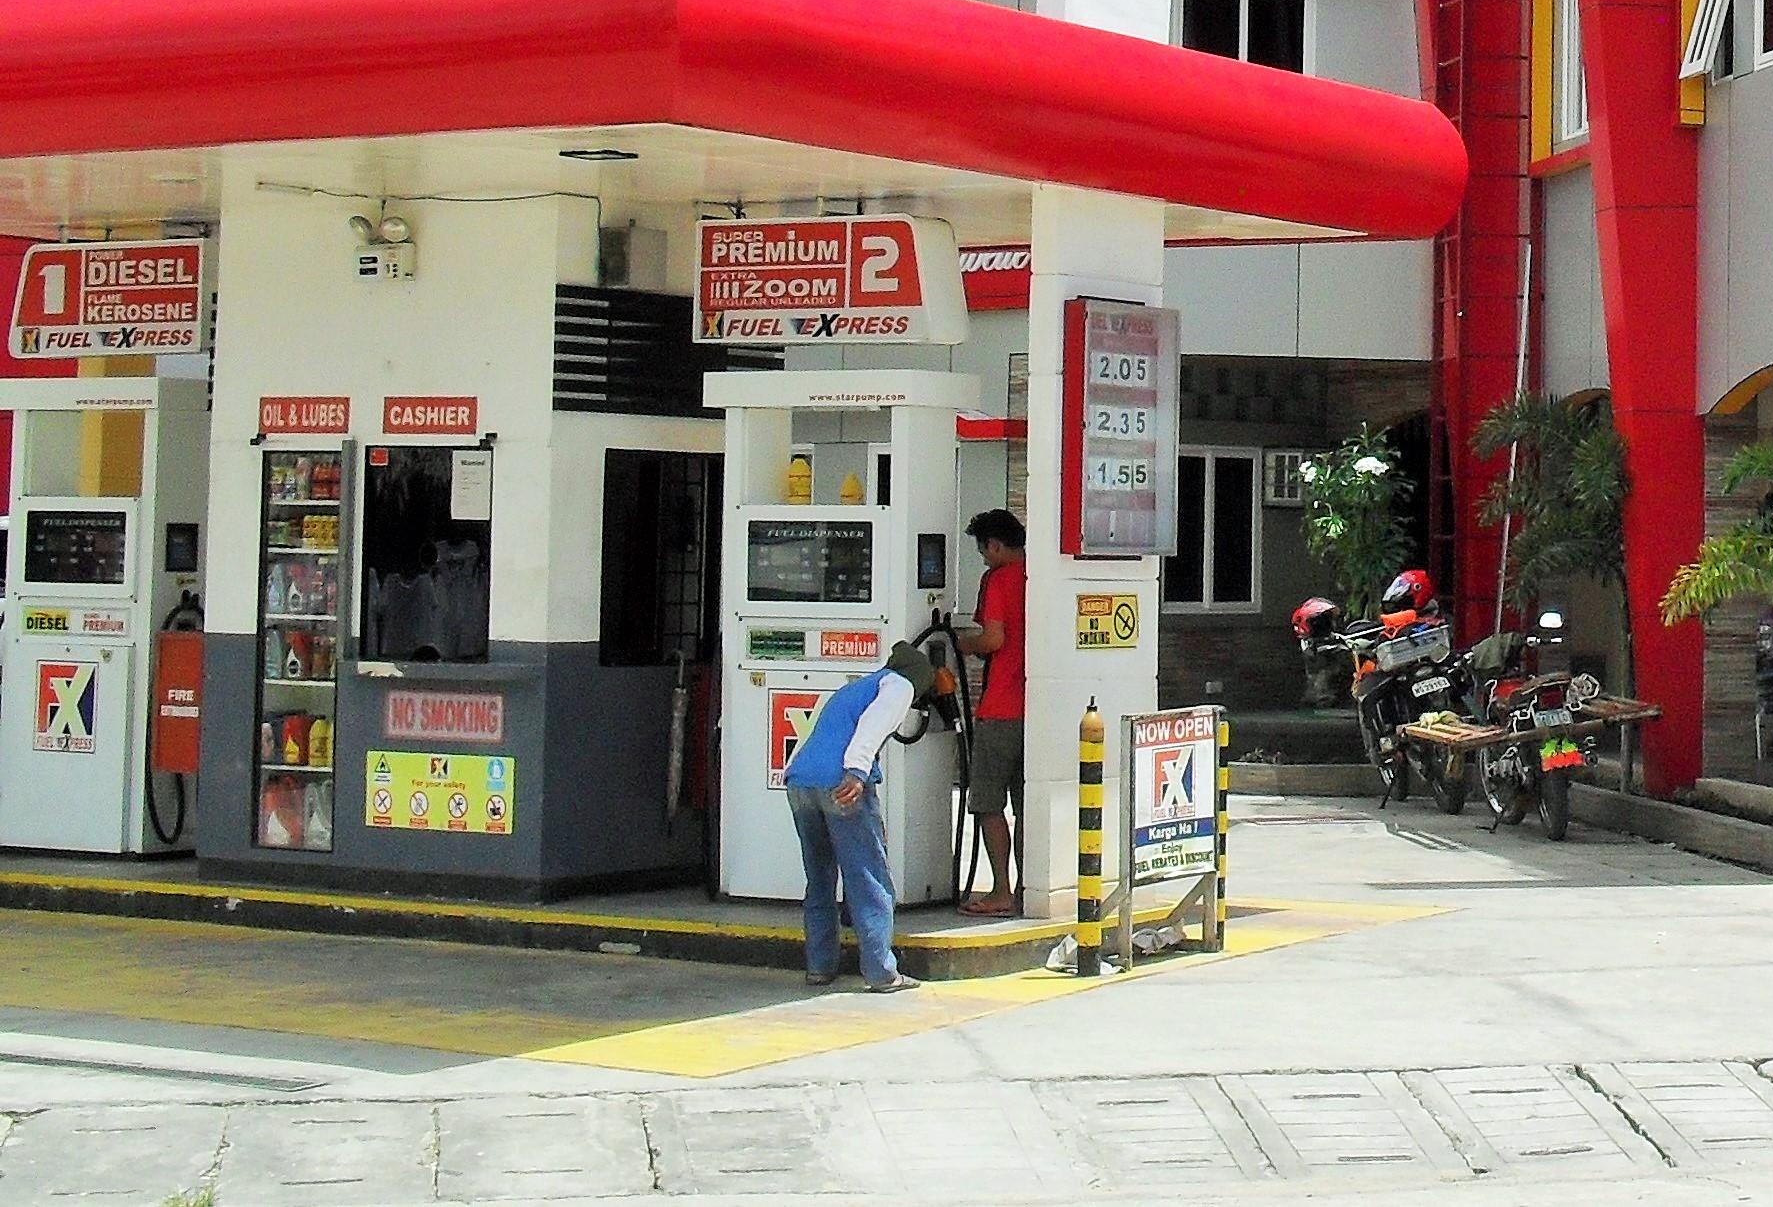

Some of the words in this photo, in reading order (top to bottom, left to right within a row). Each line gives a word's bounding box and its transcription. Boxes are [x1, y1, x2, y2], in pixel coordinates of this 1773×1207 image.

[87, 258, 193, 285] DIESEL
[861, 236, 899, 292] 2
[38, 264, 66, 315] 1
[744, 278, 838, 298] ZOOM
[87, 302, 193, 323] KEROSENE
[726, 318, 783, 337] FUEL
[798, 313, 909, 337] EXPRESS
[46, 332, 93, 348] FUEL
[106, 327, 193, 349] EXPRESS
[1099, 356, 1147, 381] 2.05
[808, 393, 906, 403] www.starpump.com
[263, 404, 284, 426] OIL
[289, 403, 298, 426] &
[301, 403, 345, 427] LUBES
[390, 405, 470, 426] CASHIER
[1097, 411, 1146, 434] 2.35
[26, 616, 69, 630] DIESEL
[1079, 632, 1110, 645] SMOKING
[168, 689, 195, 701] FIRE
[391, 697, 415, 730] NO
[421, 699, 498, 733] SMOKING
[1136, 720, 1172, 744] NOW
[1174, 716, 1214, 739] OPEN
